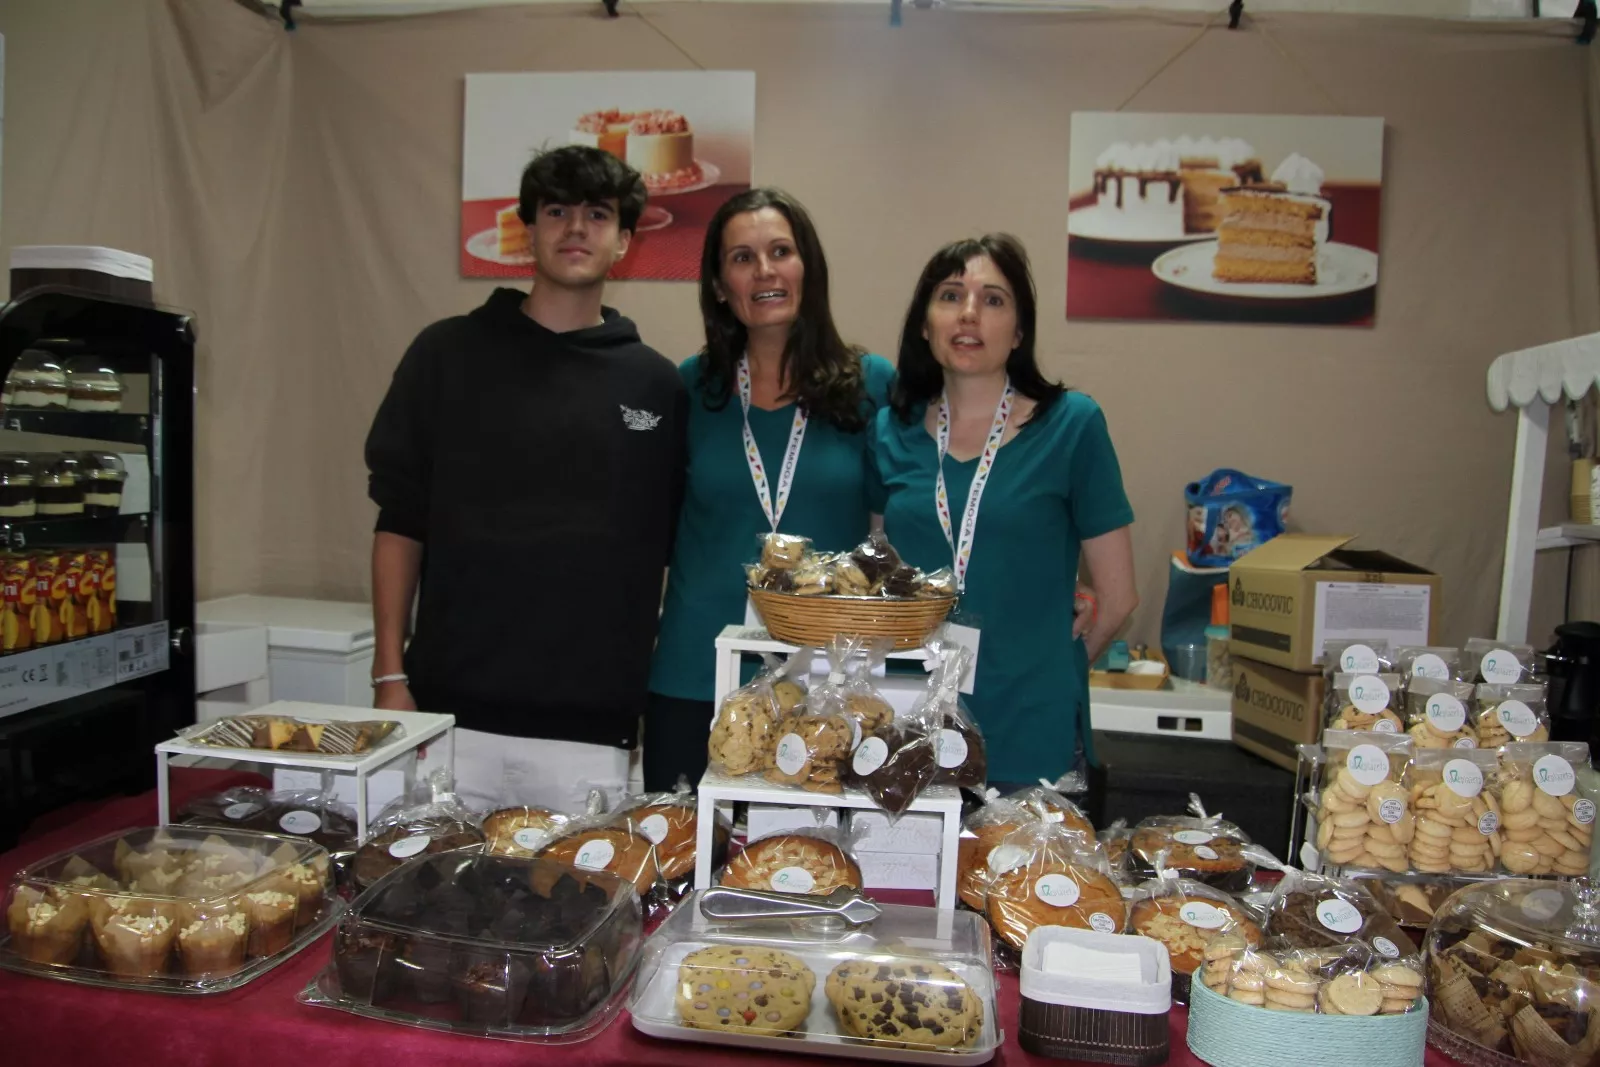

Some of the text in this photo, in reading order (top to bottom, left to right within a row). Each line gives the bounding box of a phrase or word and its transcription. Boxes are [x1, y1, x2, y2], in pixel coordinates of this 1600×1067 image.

[780, 437, 800, 488] FEMOGA
[964, 482, 982, 537] FEMOGA
[1246, 591, 1294, 615] CHOCOVIC
[1251, 688, 1305, 722] CHOCOVIC
